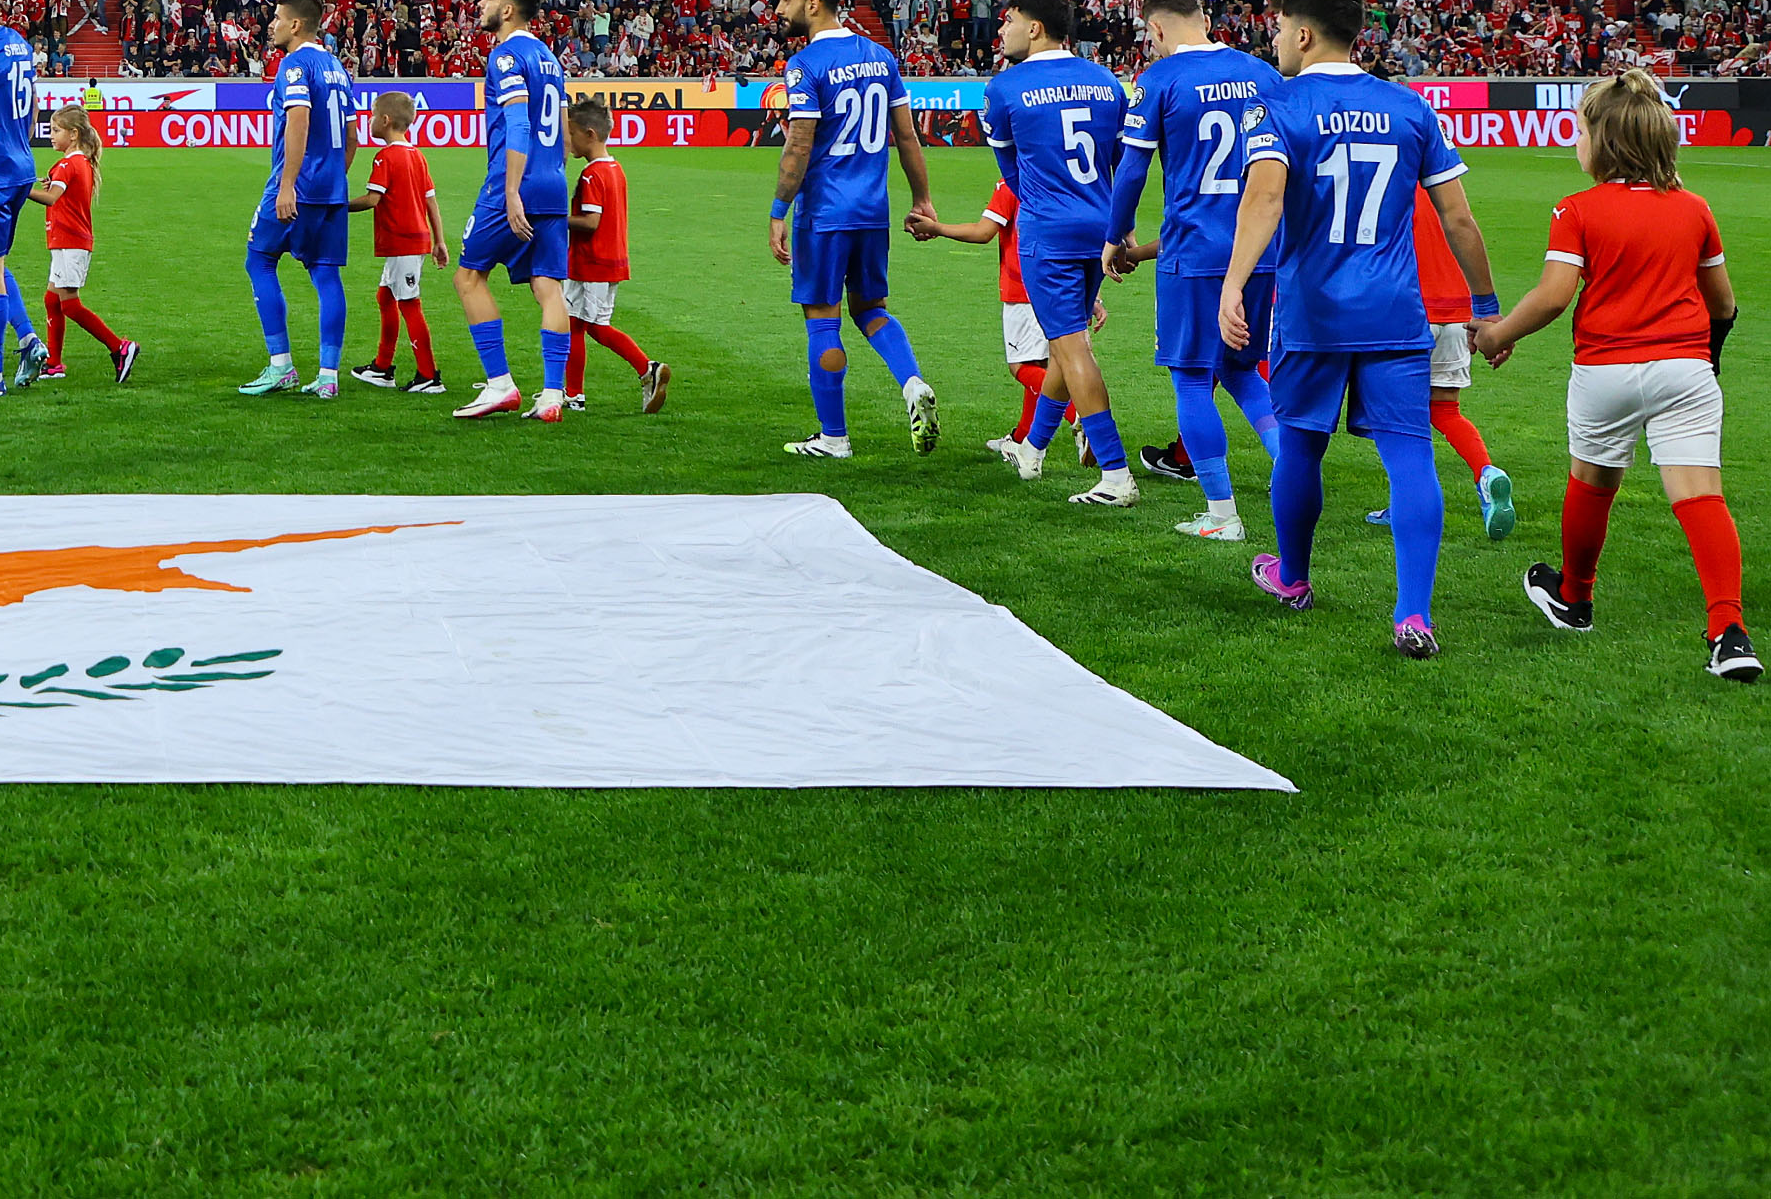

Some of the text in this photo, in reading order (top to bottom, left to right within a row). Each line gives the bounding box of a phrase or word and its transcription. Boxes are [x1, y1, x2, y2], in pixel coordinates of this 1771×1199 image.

[7, 61, 32, 119] 15
[828, 62, 889, 85] KASTANOS
[1021, 84, 1115, 107] CHARALAMPOUS
[1195, 81, 1257, 103] TZIONIS
[538, 84, 560, 147] 9
[829, 82, 889, 156] 20
[1316, 111, 1390, 134] LOIZOU
[1060, 107, 1099, 185] 5
[1316, 142, 1398, 244] 17
